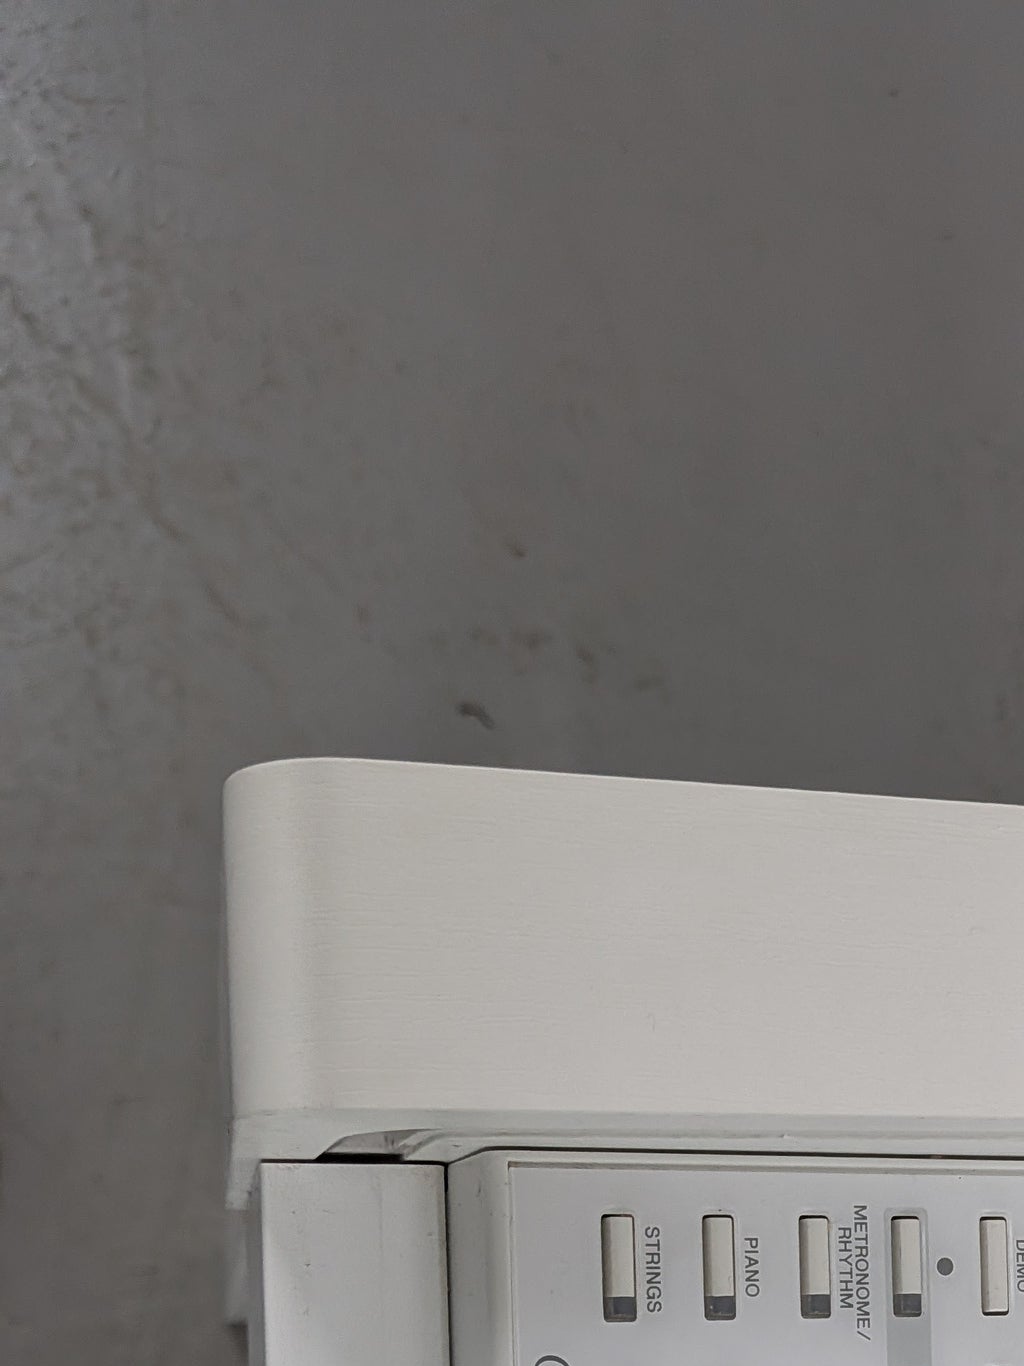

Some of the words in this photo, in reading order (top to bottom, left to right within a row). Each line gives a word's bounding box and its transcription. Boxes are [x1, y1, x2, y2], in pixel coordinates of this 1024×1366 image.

[644, 1226, 662, 1313] STRINGS
[744, 1236, 760, 1298] PIANO
[838, 1227, 854, 1309] RHYTHM
